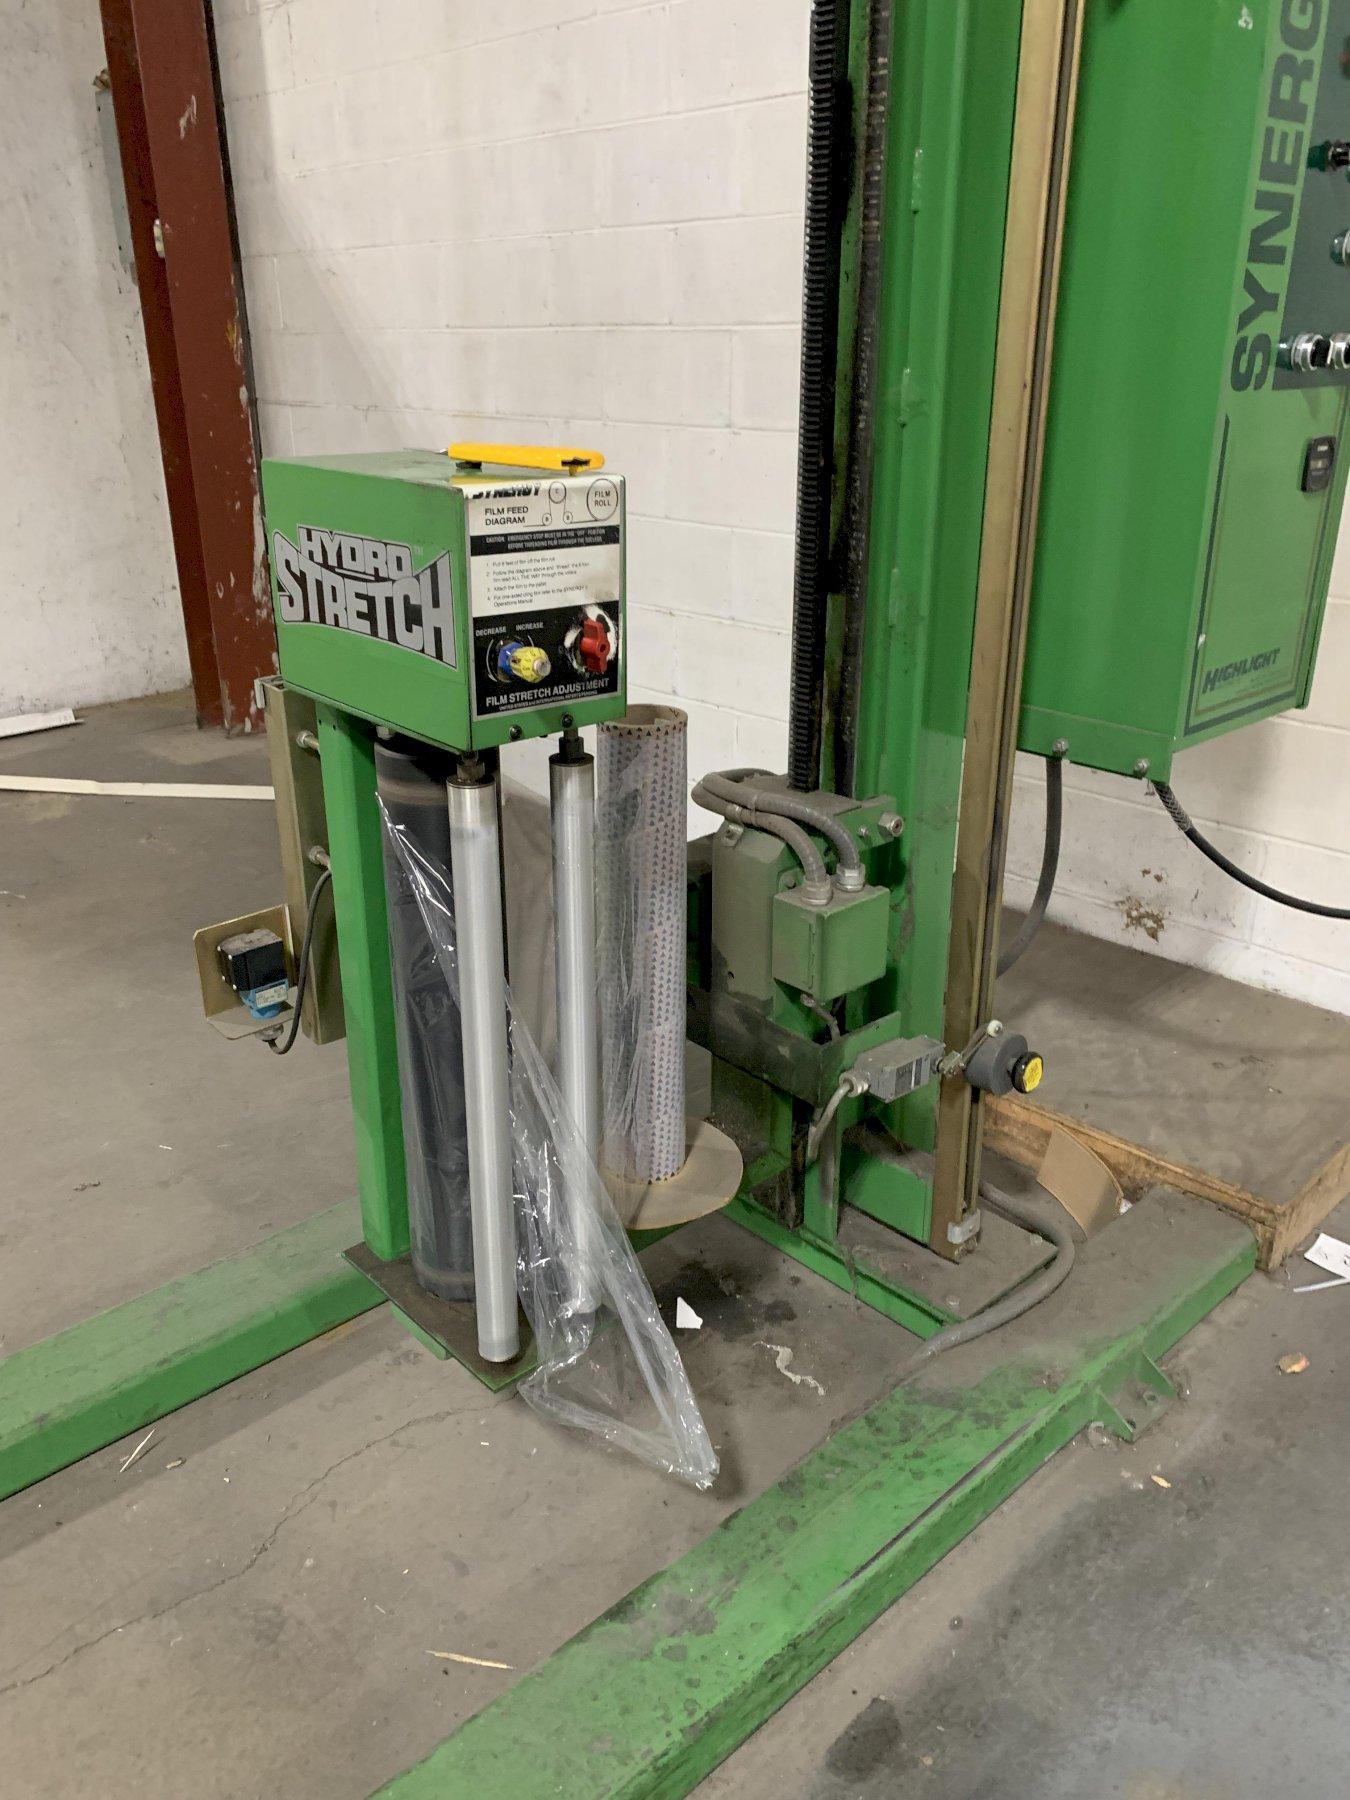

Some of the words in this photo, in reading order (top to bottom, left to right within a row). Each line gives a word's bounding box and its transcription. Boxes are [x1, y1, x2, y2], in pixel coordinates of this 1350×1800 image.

[1230, 0, 1322, 393] SYNERG
[594, 490, 611, 498] FILM
[594, 499, 611, 507] ROLL
[485, 507, 505, 516] FILM
[507, 505, 529, 514] FEED
[485, 516, 526, 526] DIAGRAM
[298, 524, 413, 581] HYDRO
[273, 528, 457, 670] STRETCH
[475, 626, 507, 637] DECREASE
[515, 621, 544, 631] INCREASE
[1202, 647, 1280, 695] HIGHLIGHT
[486, 694, 508, 707] FILM
[509, 687, 551, 702] STRETCH
[552, 678, 610, 695] ADJUSTMENT
